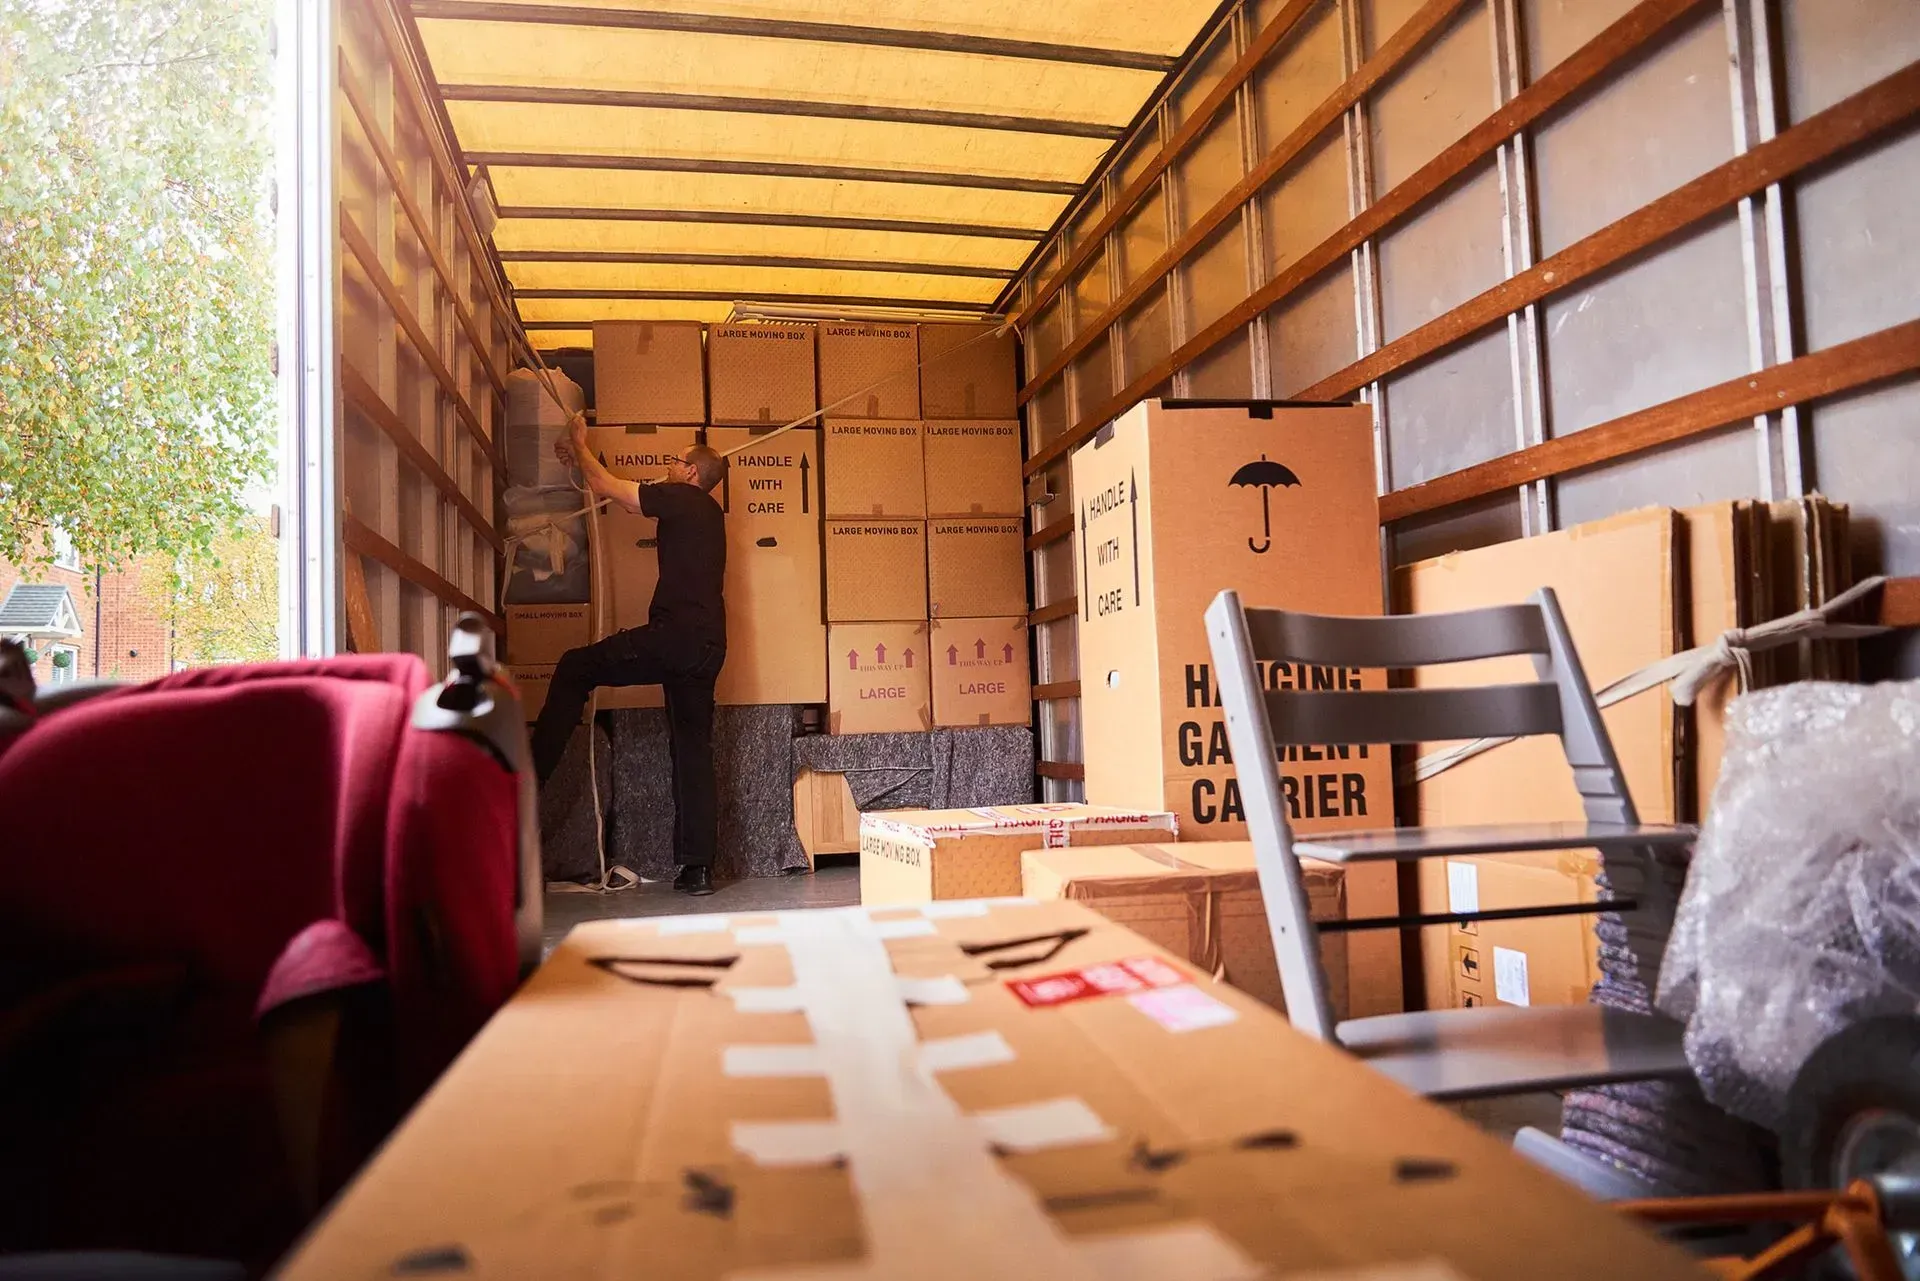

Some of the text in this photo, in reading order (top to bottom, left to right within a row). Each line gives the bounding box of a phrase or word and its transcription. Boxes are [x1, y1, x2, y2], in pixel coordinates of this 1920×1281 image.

[717, 329, 806, 341] LARGE MOVING BOX
[826, 327, 856, 337] LARGE
[893, 329, 911, 339] BOX
[832, 426, 917, 436] LARGE MOVING BOX
[931, 426, 1013, 436] LARGE MOVING BOX
[615, 454, 672, 467] HANDLE
[738, 455, 793, 467] HANDLE
[749, 479, 783, 490] WITH
[1090, 481, 1125, 520] HANDLE
[747, 502, 785, 514] CARE
[833, 527, 918, 535] LARGE MOVING BOX
[935, 525, 1019, 534] LARGE MOVING BOX
[1097, 537, 1120, 567] WITH
[1097, 588, 1123, 617] CARE
[514, 611, 539, 620] SMALL
[540, 611, 568, 619] MOVING
[877, 664, 893, 672] WAY
[959, 660, 976, 668] THIS
[977, 659, 992, 667] WAY
[859, 687, 906, 700] LARGE
[959, 682, 1006, 695] LARGE
[1191, 773, 1369, 825] CARIER
[862, 835, 921, 868] LARGE MOVING BOX
